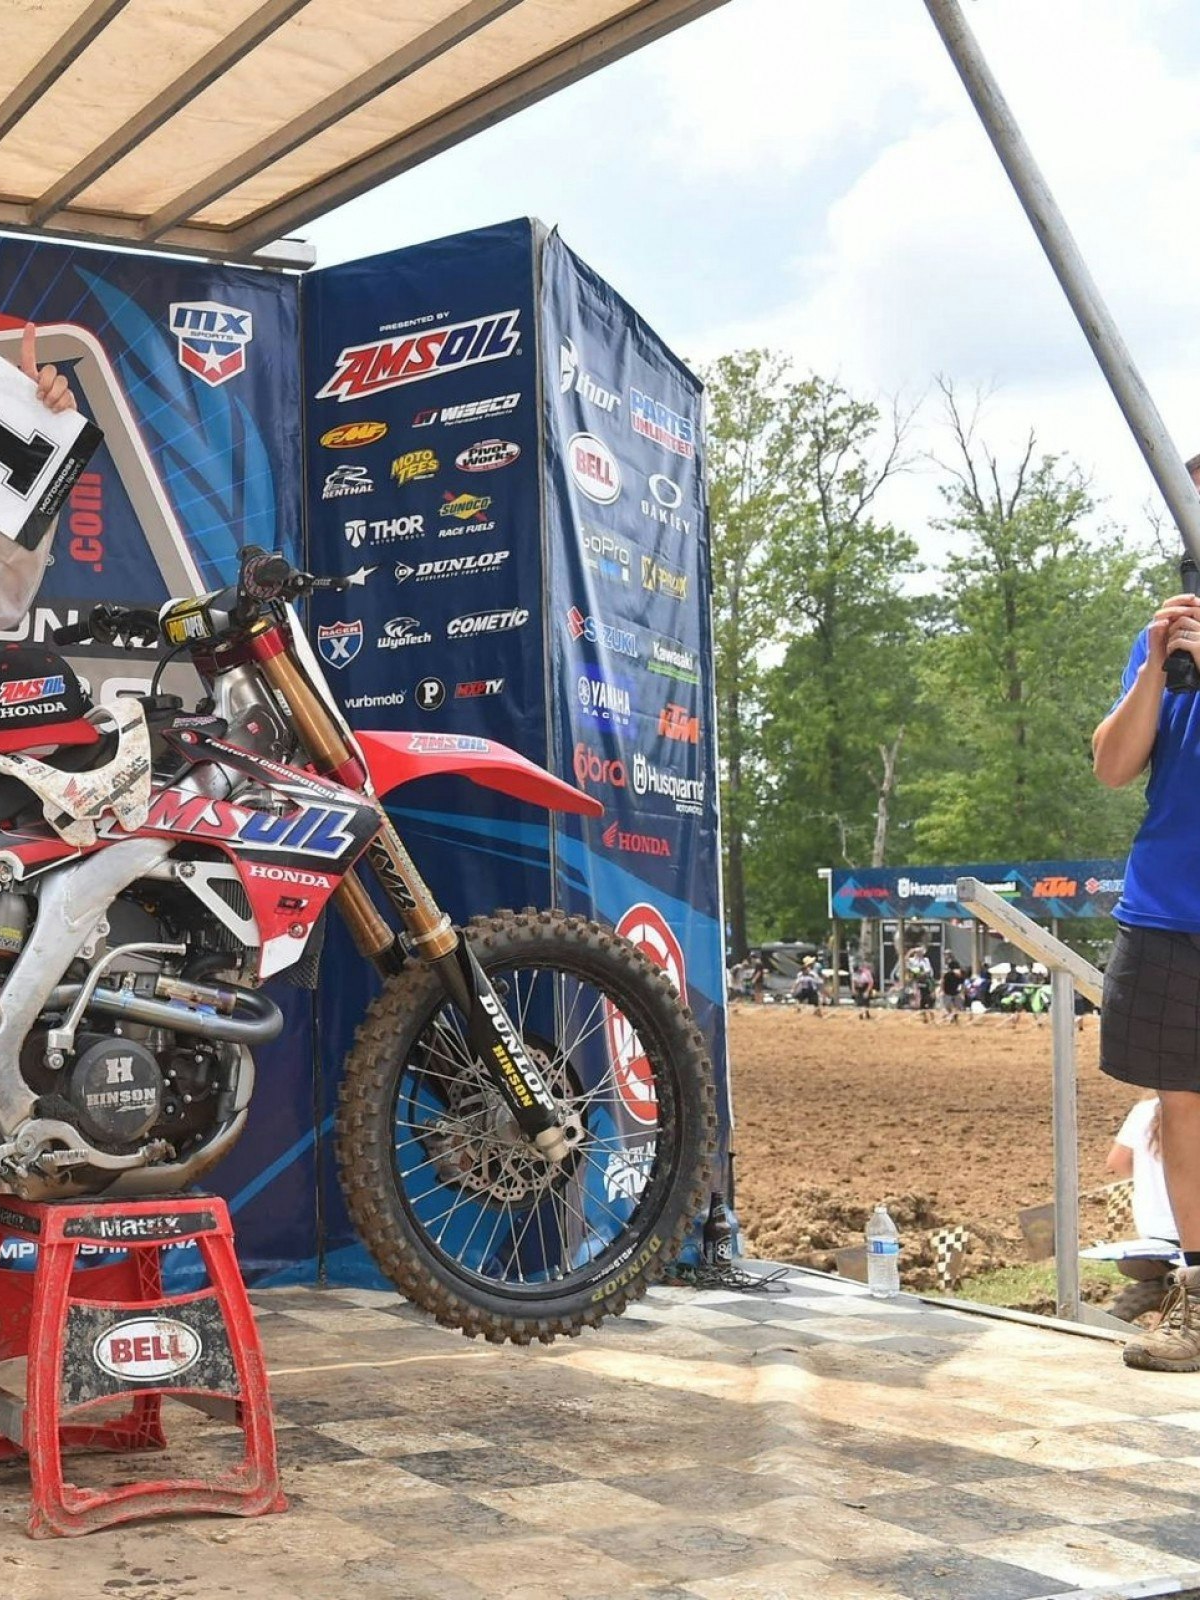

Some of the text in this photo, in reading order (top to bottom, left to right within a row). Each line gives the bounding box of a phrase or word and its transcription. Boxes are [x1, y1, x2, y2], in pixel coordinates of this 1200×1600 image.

[379, 310, 451, 332] PRESENTED BY
[190, 330, 234, 341] SPORTS
[322, 312, 519, 399] AMSOIL
[575, 371, 622, 413] thor
[629, 386, 693, 443] PARTS
[320, 423, 388, 447] FMF
[631, 414, 694, 461] UNLIMITED
[391, 450, 434, 472] MOTO
[462, 451, 515, 466] Works
[468, 443, 508, 457] Pivot
[397, 459, 440, 484] TEES
[574, 446, 614, 488] BELL
[39, 457, 75, 512] MOTOCROSS
[322, 484, 375, 500] RENTHAL
[441, 497, 492, 516] SUNOCO
[640, 499, 691, 535] OAKLEY
[370, 514, 425, 540] THOR
[438, 521, 496, 538] RACE FUELS
[415, 550, 511, 577] DUNLOP
[320, 625, 360, 637] RACER
[446, 607, 530, 634] COMETIC
[329, 636, 351, 661] X
[377, 633, 432, 650] WyoTech
[583, 615, 638, 658] SZUKI
[652, 641, 693, 670] Kawasaki
[345, 692, 406, 709] vurbmoto
[423, 682, 439, 705] P
[591, 680, 631, 717] YAMAHA
[0, 701, 69, 719] HONDA
[657, 702, 699, 744] KTM
[412, 734, 490, 752] AMSOIL
[648, 764, 705, 801] Husqvarna
[135, 790, 352, 855] MSOIL
[617, 832, 671, 857] HONDA
[249, 865, 331, 890] HONDA
[1032, 877, 1078, 898] KTM
[478, 993, 555, 1111] DUNLOP
[104, 1056, 135, 1085] H
[491, 1044, 534, 1108] HINSON
[85, 1087, 157, 1107] HINSON
[100, 1216, 182, 1238] Matrix
[109, 1334, 188, 1364] BELL
